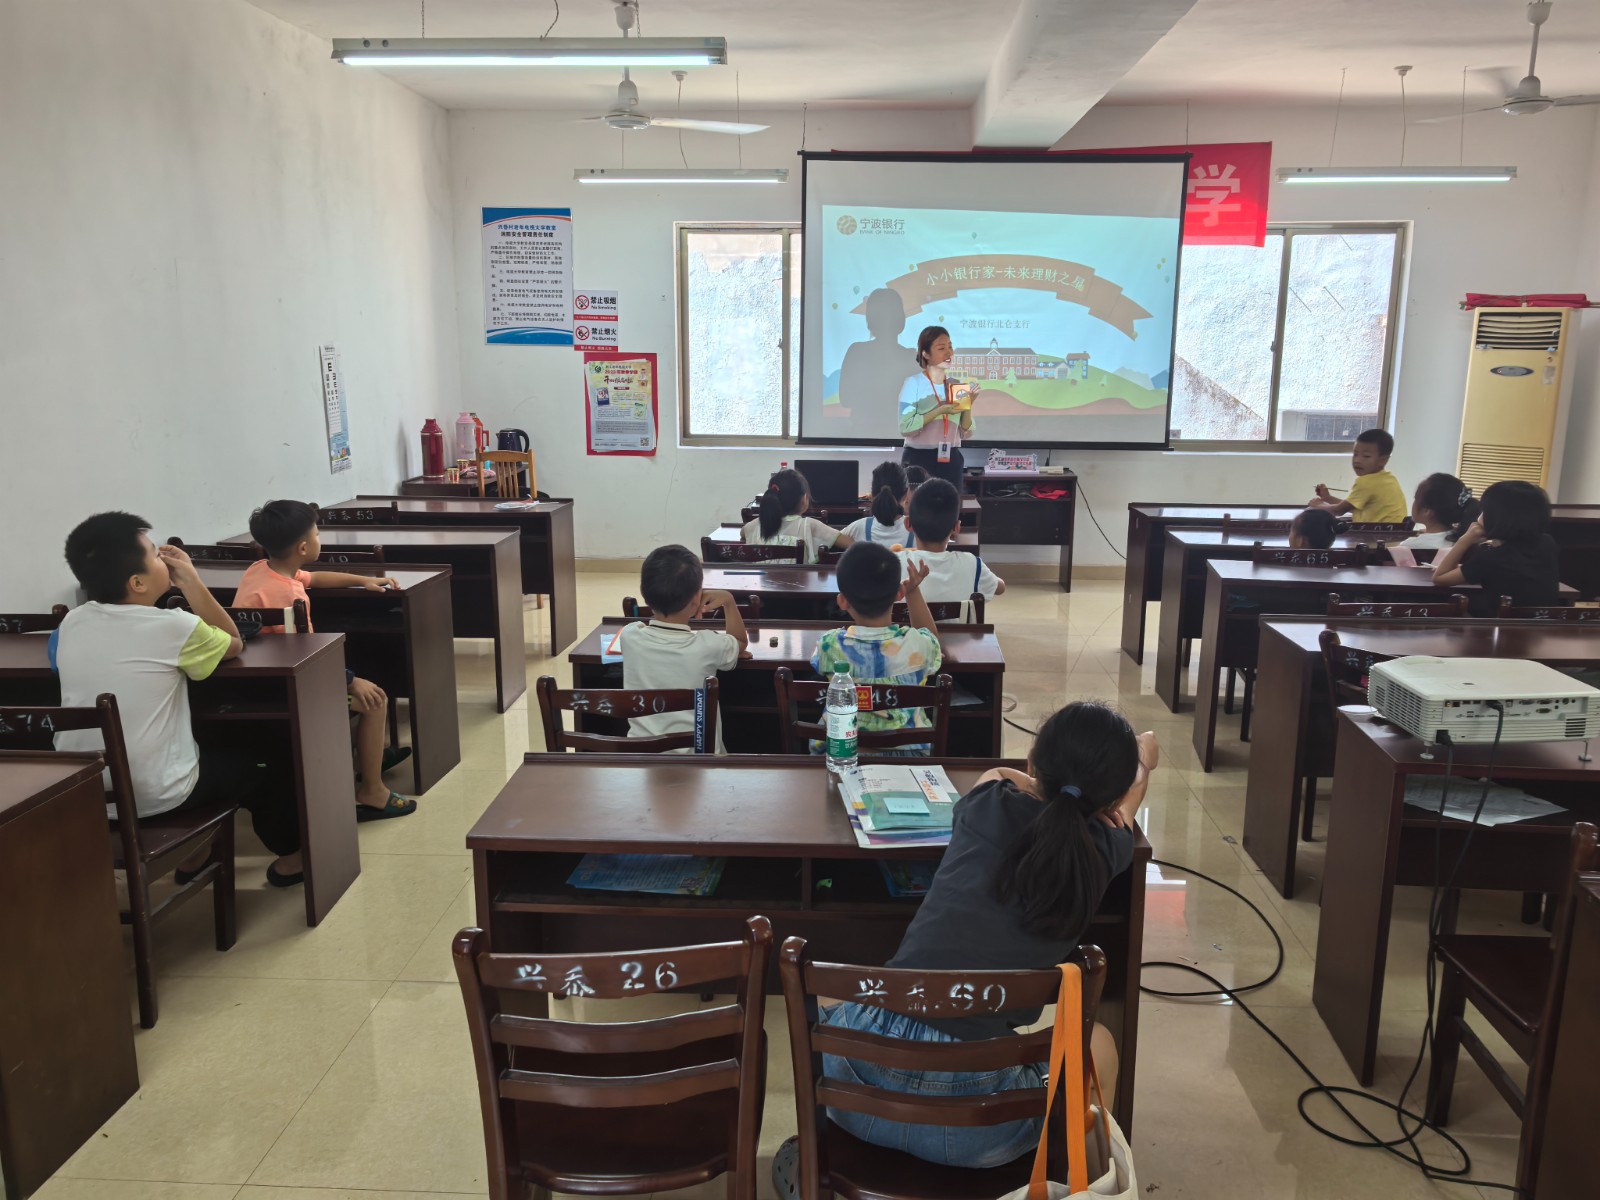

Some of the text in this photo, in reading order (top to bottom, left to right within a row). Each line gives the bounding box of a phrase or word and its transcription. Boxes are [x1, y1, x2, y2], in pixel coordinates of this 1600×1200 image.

[1186, 164, 1241, 227] 学
[860, 218, 905, 230] 宁波银行
[926, 265, 1085, 291] 小小银行家-未来理财之星
[590, 296, 617, 305] 禁止吸烟
[591, 327, 617, 336] 禁止烟火
[960, 319, 1031, 329] 宁波银行北仑支行
[1306, 552, 1329, 565] 65
[632, 695, 666, 713] 30
[696, 691, 704, 722] SUNDAY
[620, 961, 678, 990] 26
[949, 982, 1006, 1012] 60
